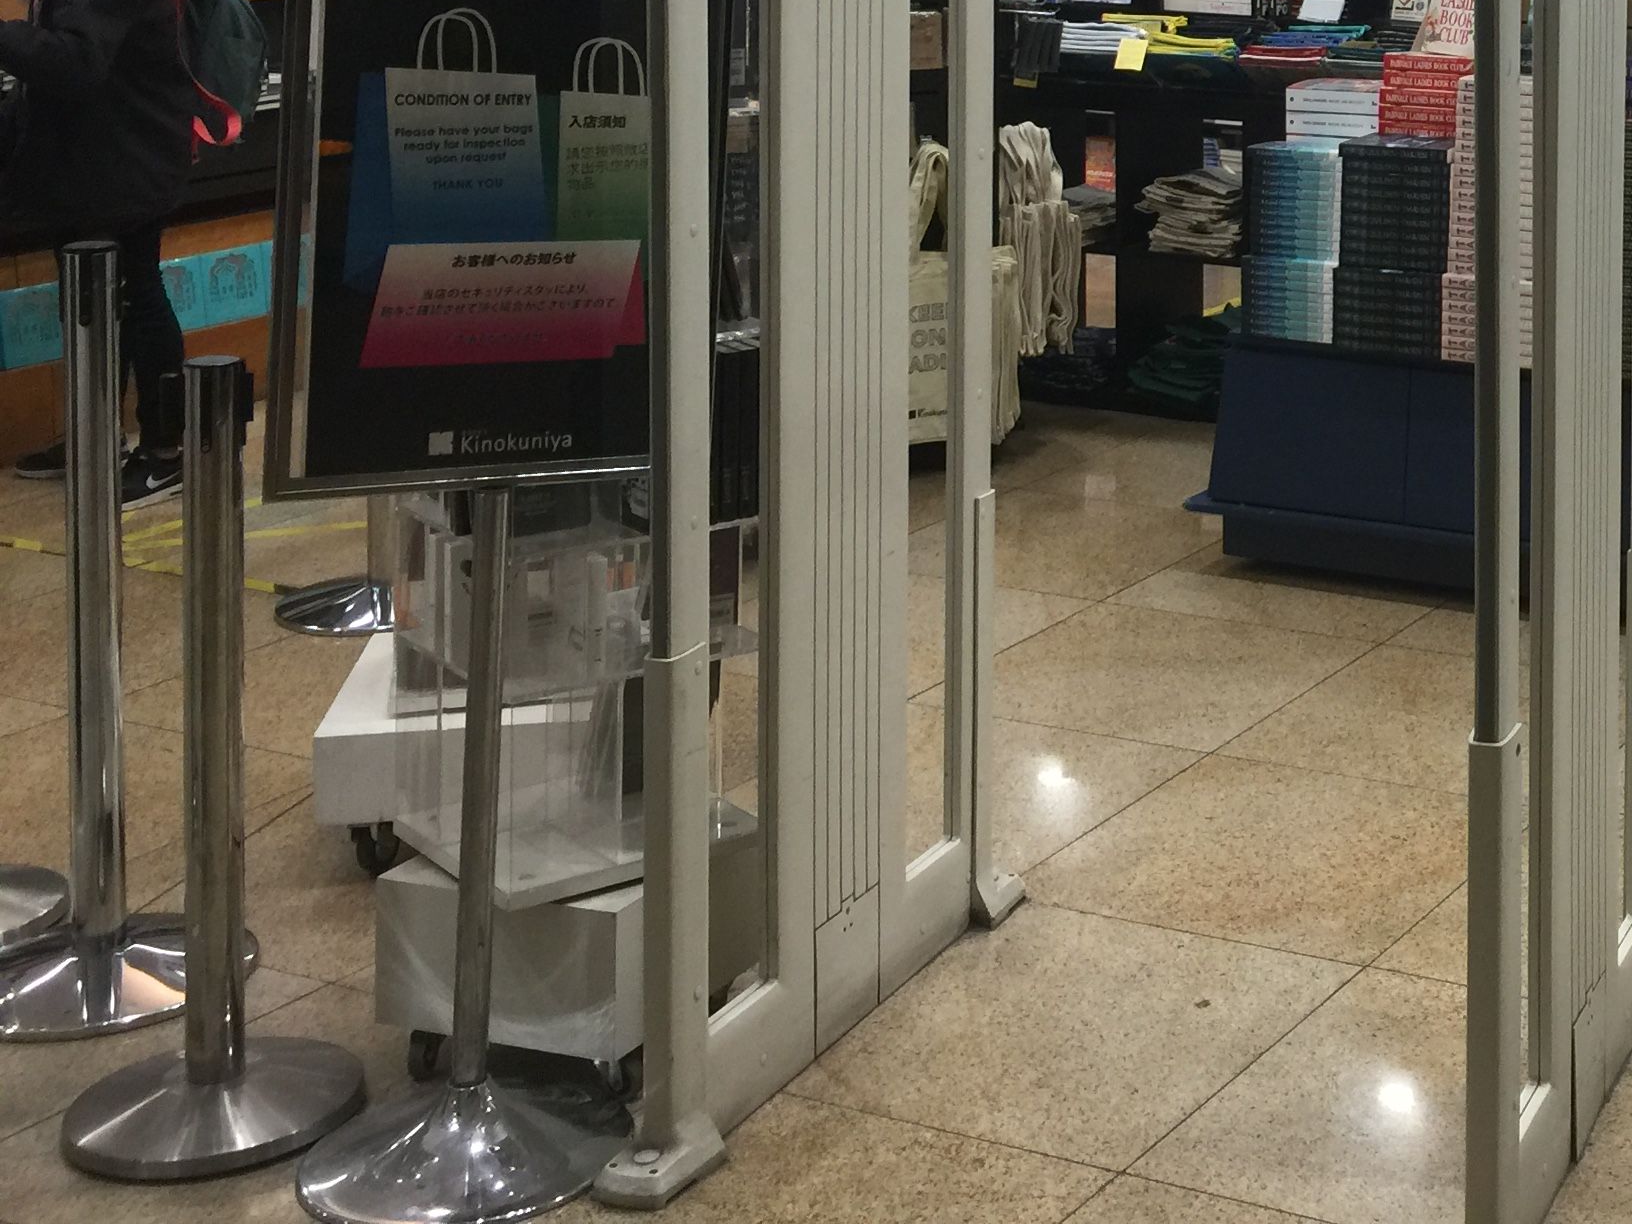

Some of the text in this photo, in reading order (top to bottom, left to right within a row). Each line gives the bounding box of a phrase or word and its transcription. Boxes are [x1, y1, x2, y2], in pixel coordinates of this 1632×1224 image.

[1440, 28, 1469, 45] CLUB
[395, 94, 532, 106] CONDITION OF ENTRY
[395, 124, 533, 137] Please have your bags
[404, 137, 525, 151] ready for inspection
[426, 152, 506, 164] upon request
[433, 178, 503, 190] THANK YOU
[451, 252, 577, 268] お客様へのお知らせ
[461, 431, 572, 453] Kinokuniya
